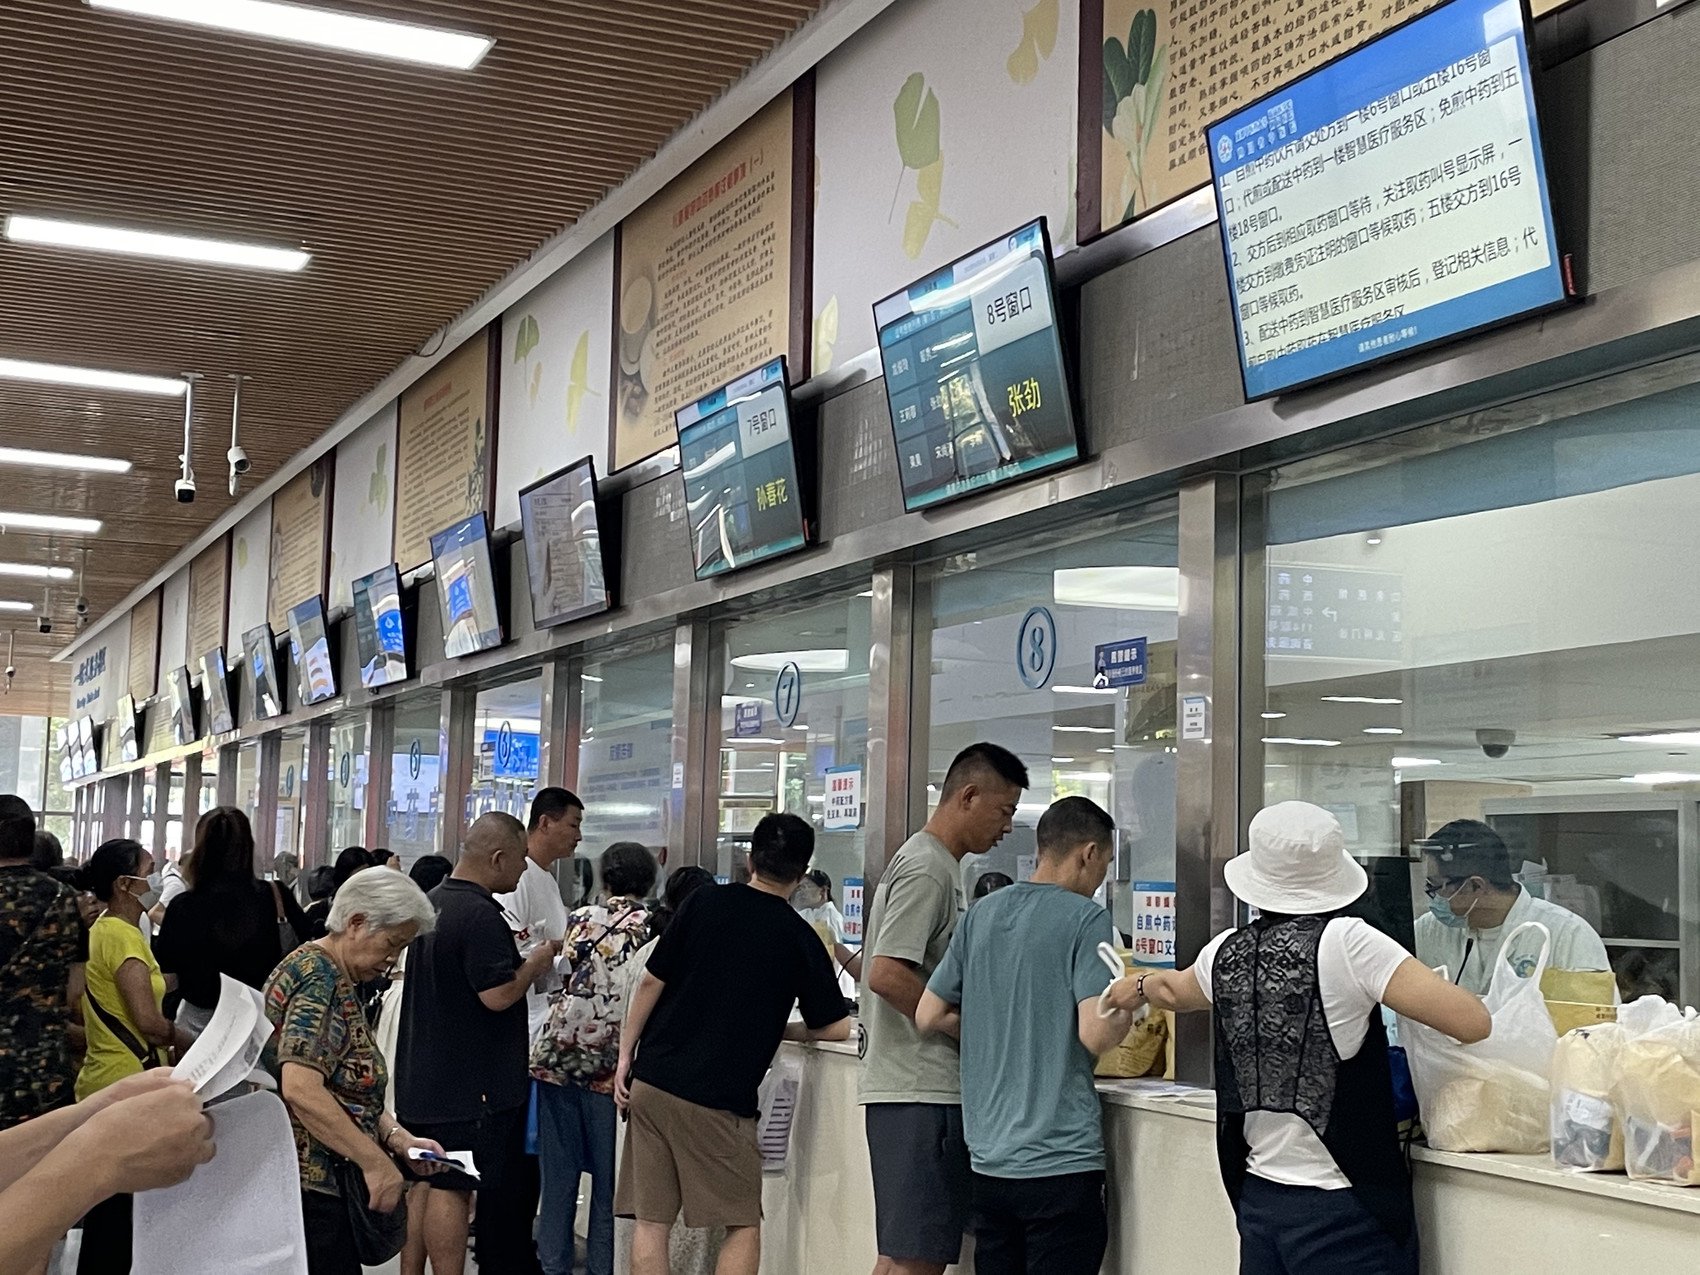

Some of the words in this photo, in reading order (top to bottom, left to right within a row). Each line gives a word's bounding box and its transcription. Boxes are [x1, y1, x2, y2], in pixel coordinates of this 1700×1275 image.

[986, 286, 1033, 325] 8号窗口
[1007, 377, 1041, 418] 张劲
[747, 407, 777, 437] 7号窗口
[1030, 626, 1044, 672] 8
